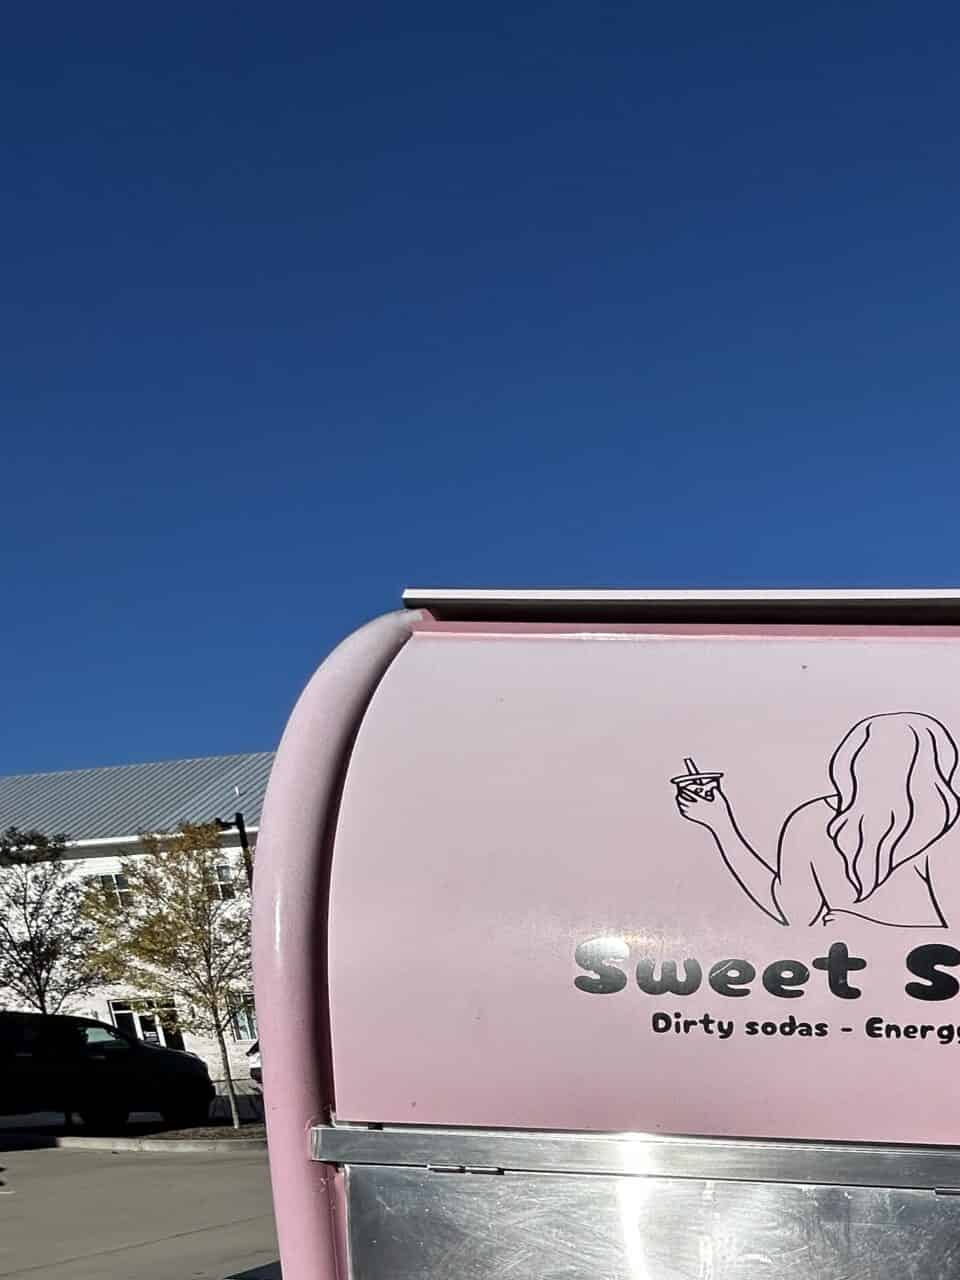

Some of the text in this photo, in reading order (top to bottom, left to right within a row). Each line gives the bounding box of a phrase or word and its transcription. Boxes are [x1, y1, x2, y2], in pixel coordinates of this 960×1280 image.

[574, 938, 866, 999] Sweet
[651, 1011, 734, 1040] Dirty
[745, 1014, 829, 1037] sodas
